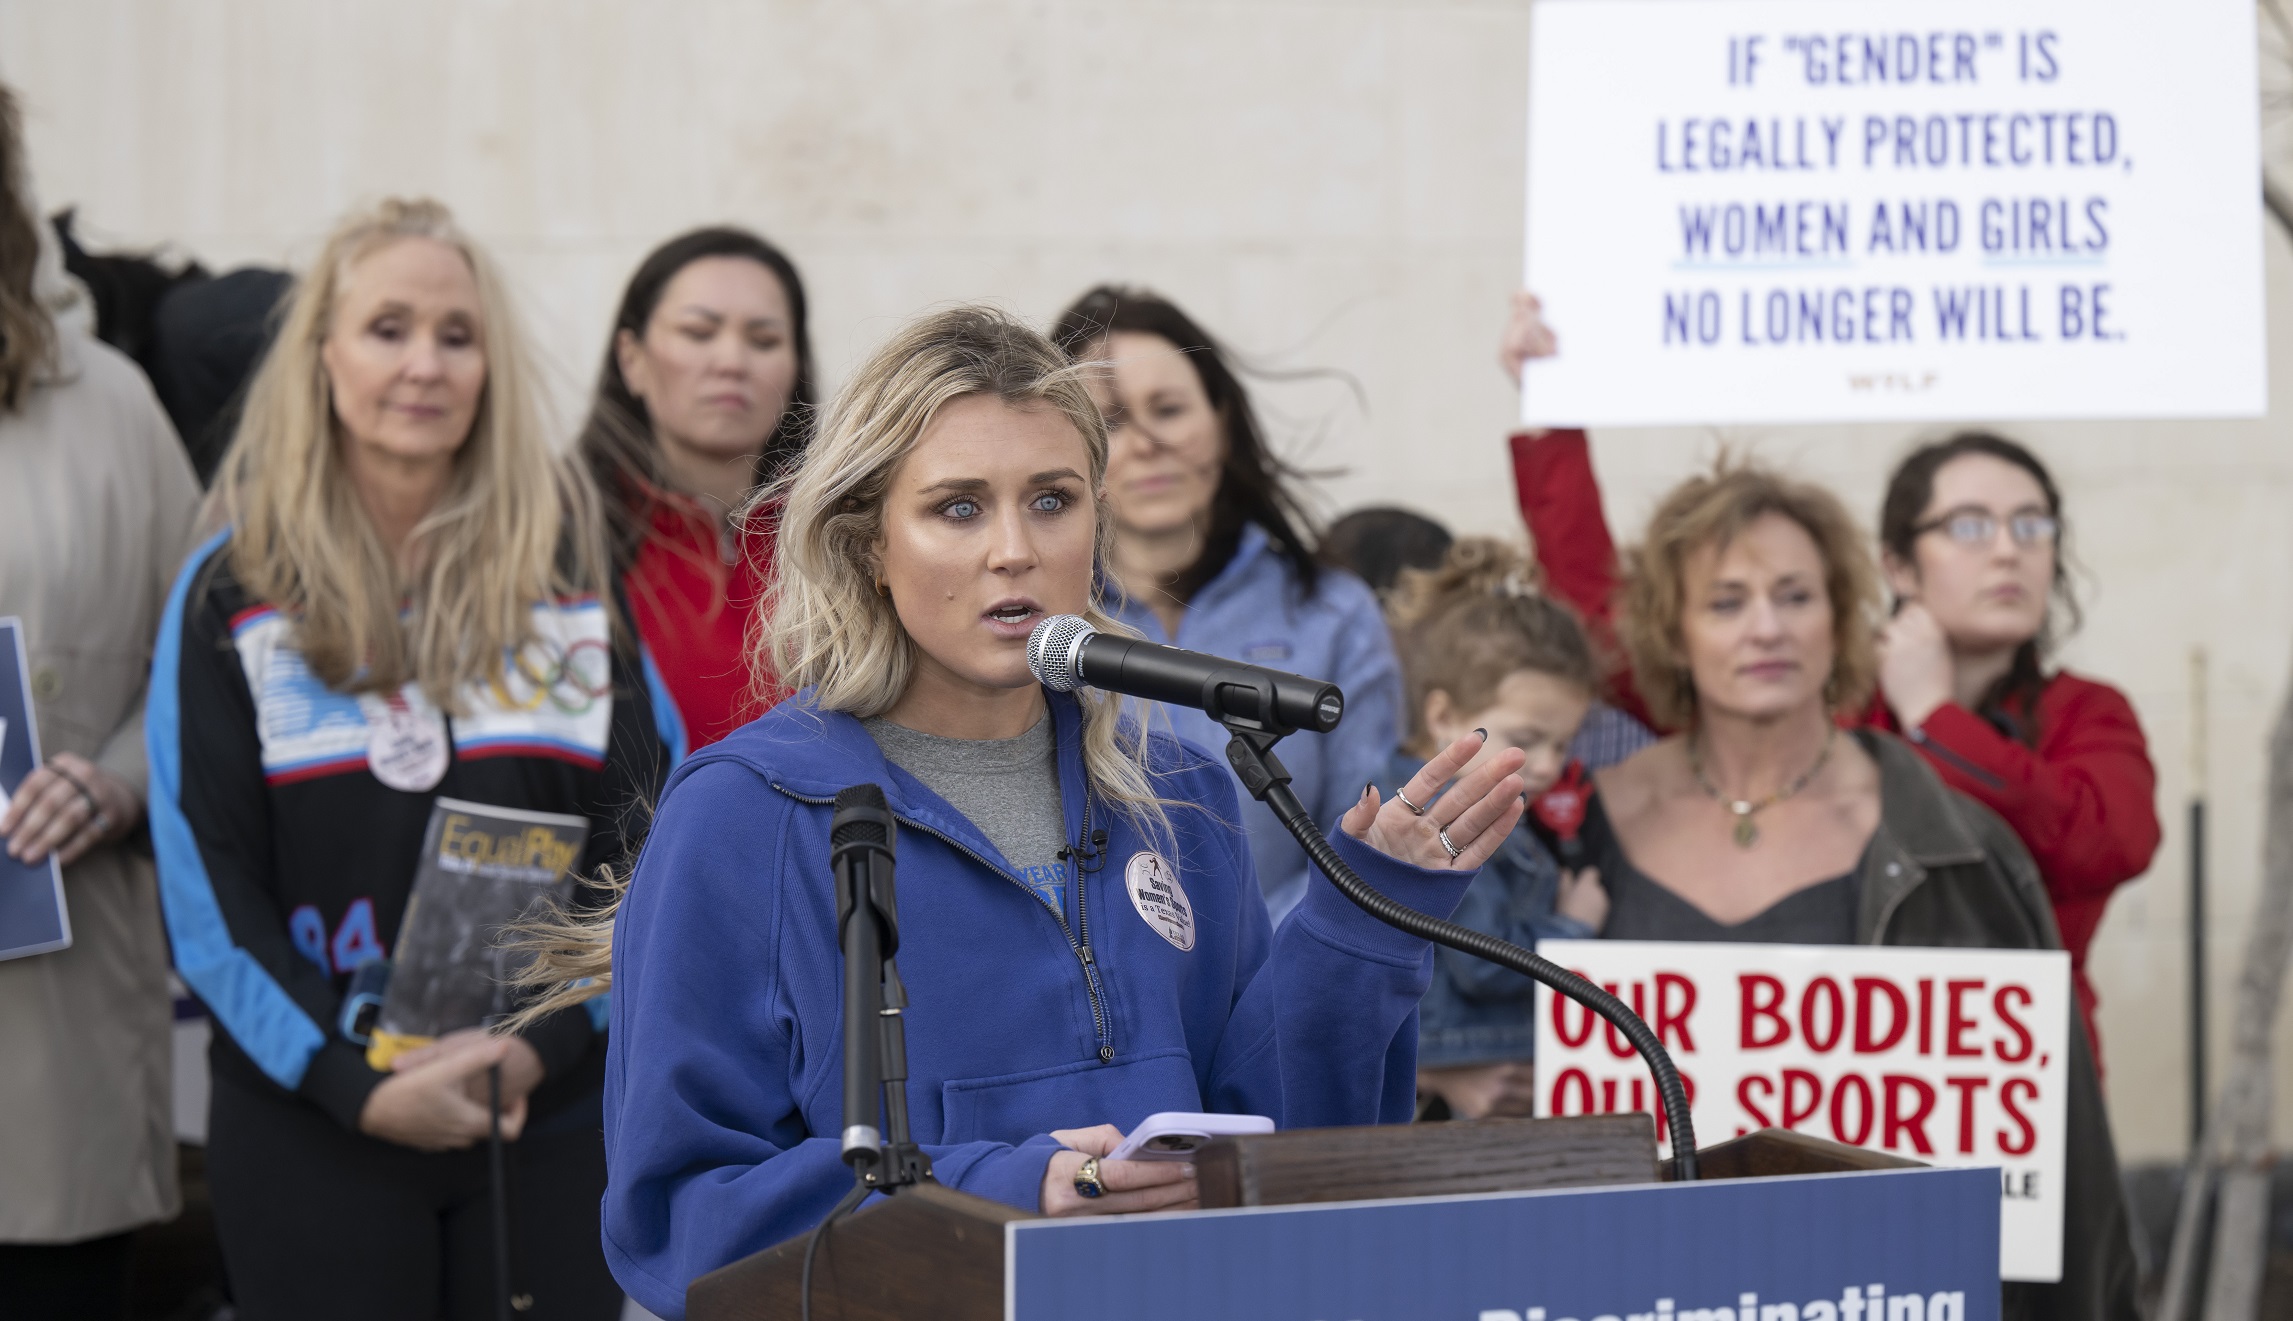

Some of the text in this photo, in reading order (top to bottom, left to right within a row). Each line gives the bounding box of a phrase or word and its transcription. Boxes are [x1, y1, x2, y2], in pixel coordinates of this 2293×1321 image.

[1728, 30, 2059, 86] IF "GENDER" IS
[1658, 112, 2132, 173] LEGALLY PROTECTED,
[1679, 197, 2109, 255] WOMEN AND GIRLS
[1663, 283, 2126, 345] NO LONGER WILL BE.
[1076, 650, 1085, 677] SHURE
[1320, 703, 1340, 713] SHURE
[1140, 902, 1148, 911] is
[1149, 877, 1173, 898] Saving
[1552, 969, 2050, 1068] OUR BODIES,
[1735, 1068, 2040, 1156] SPORTS
